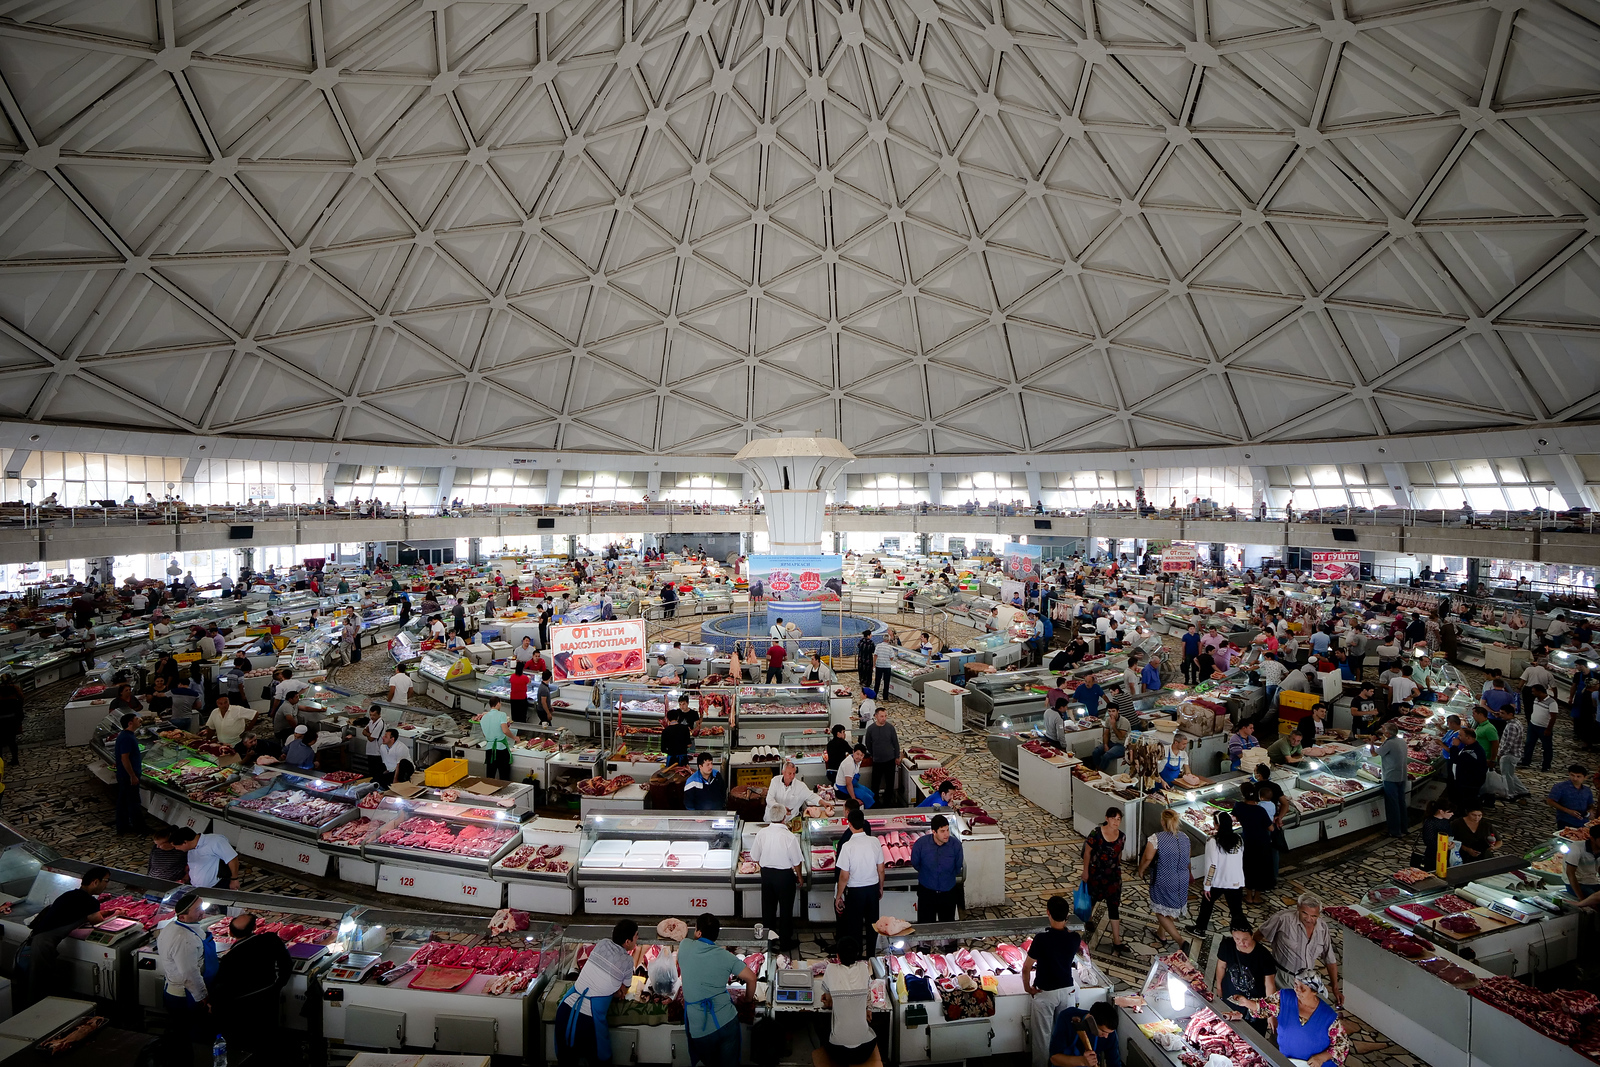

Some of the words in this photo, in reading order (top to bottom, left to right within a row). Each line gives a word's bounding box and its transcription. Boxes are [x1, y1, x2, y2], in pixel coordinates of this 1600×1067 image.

[572, 627, 590, 639] ОТ
[592, 627, 624, 637] ГЎШТИ
[560, 637, 637, 651] МАХСУЛОТЛАРИ
[254, 842, 265, 851] 130
[298, 853, 310, 863] 129
[400, 877, 414, 886] 128
[462, 885, 477, 895] 127
[612, 897, 629, 905] 126
[690, 898, 708, 907] 125
